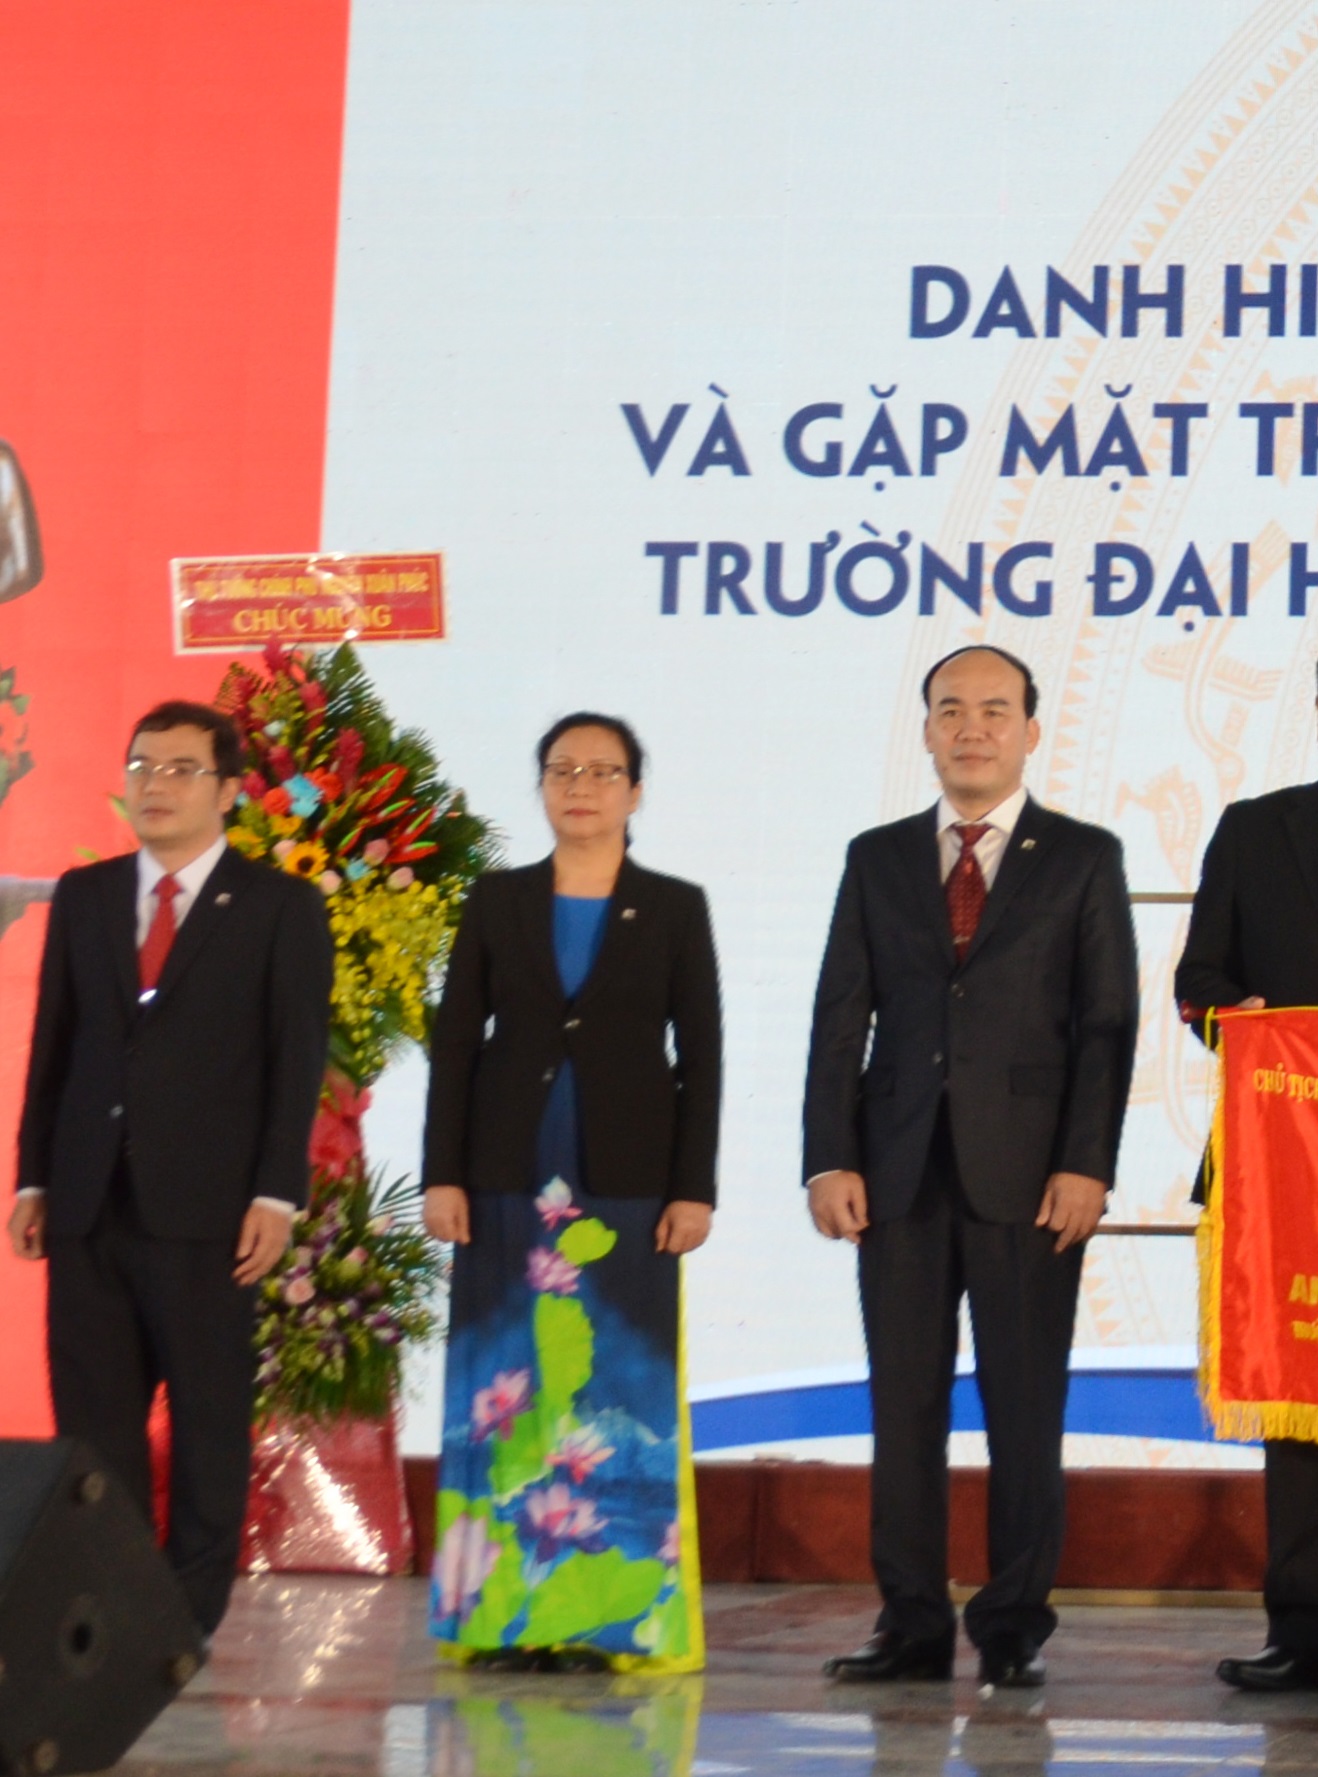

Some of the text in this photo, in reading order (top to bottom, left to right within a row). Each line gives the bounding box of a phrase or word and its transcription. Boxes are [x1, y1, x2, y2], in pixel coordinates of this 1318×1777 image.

[910, 264, 1185, 339] DANH
[621, 383, 752, 477] VÀ
[783, 384, 968, 492] GẶP
[999, 384, 1208, 492] MẶT
[231, 602, 309, 632] CHÚC
[645, 521, 1054, 618] TRƯỜNG
[1086, 542, 1249, 632] ĐẠI
